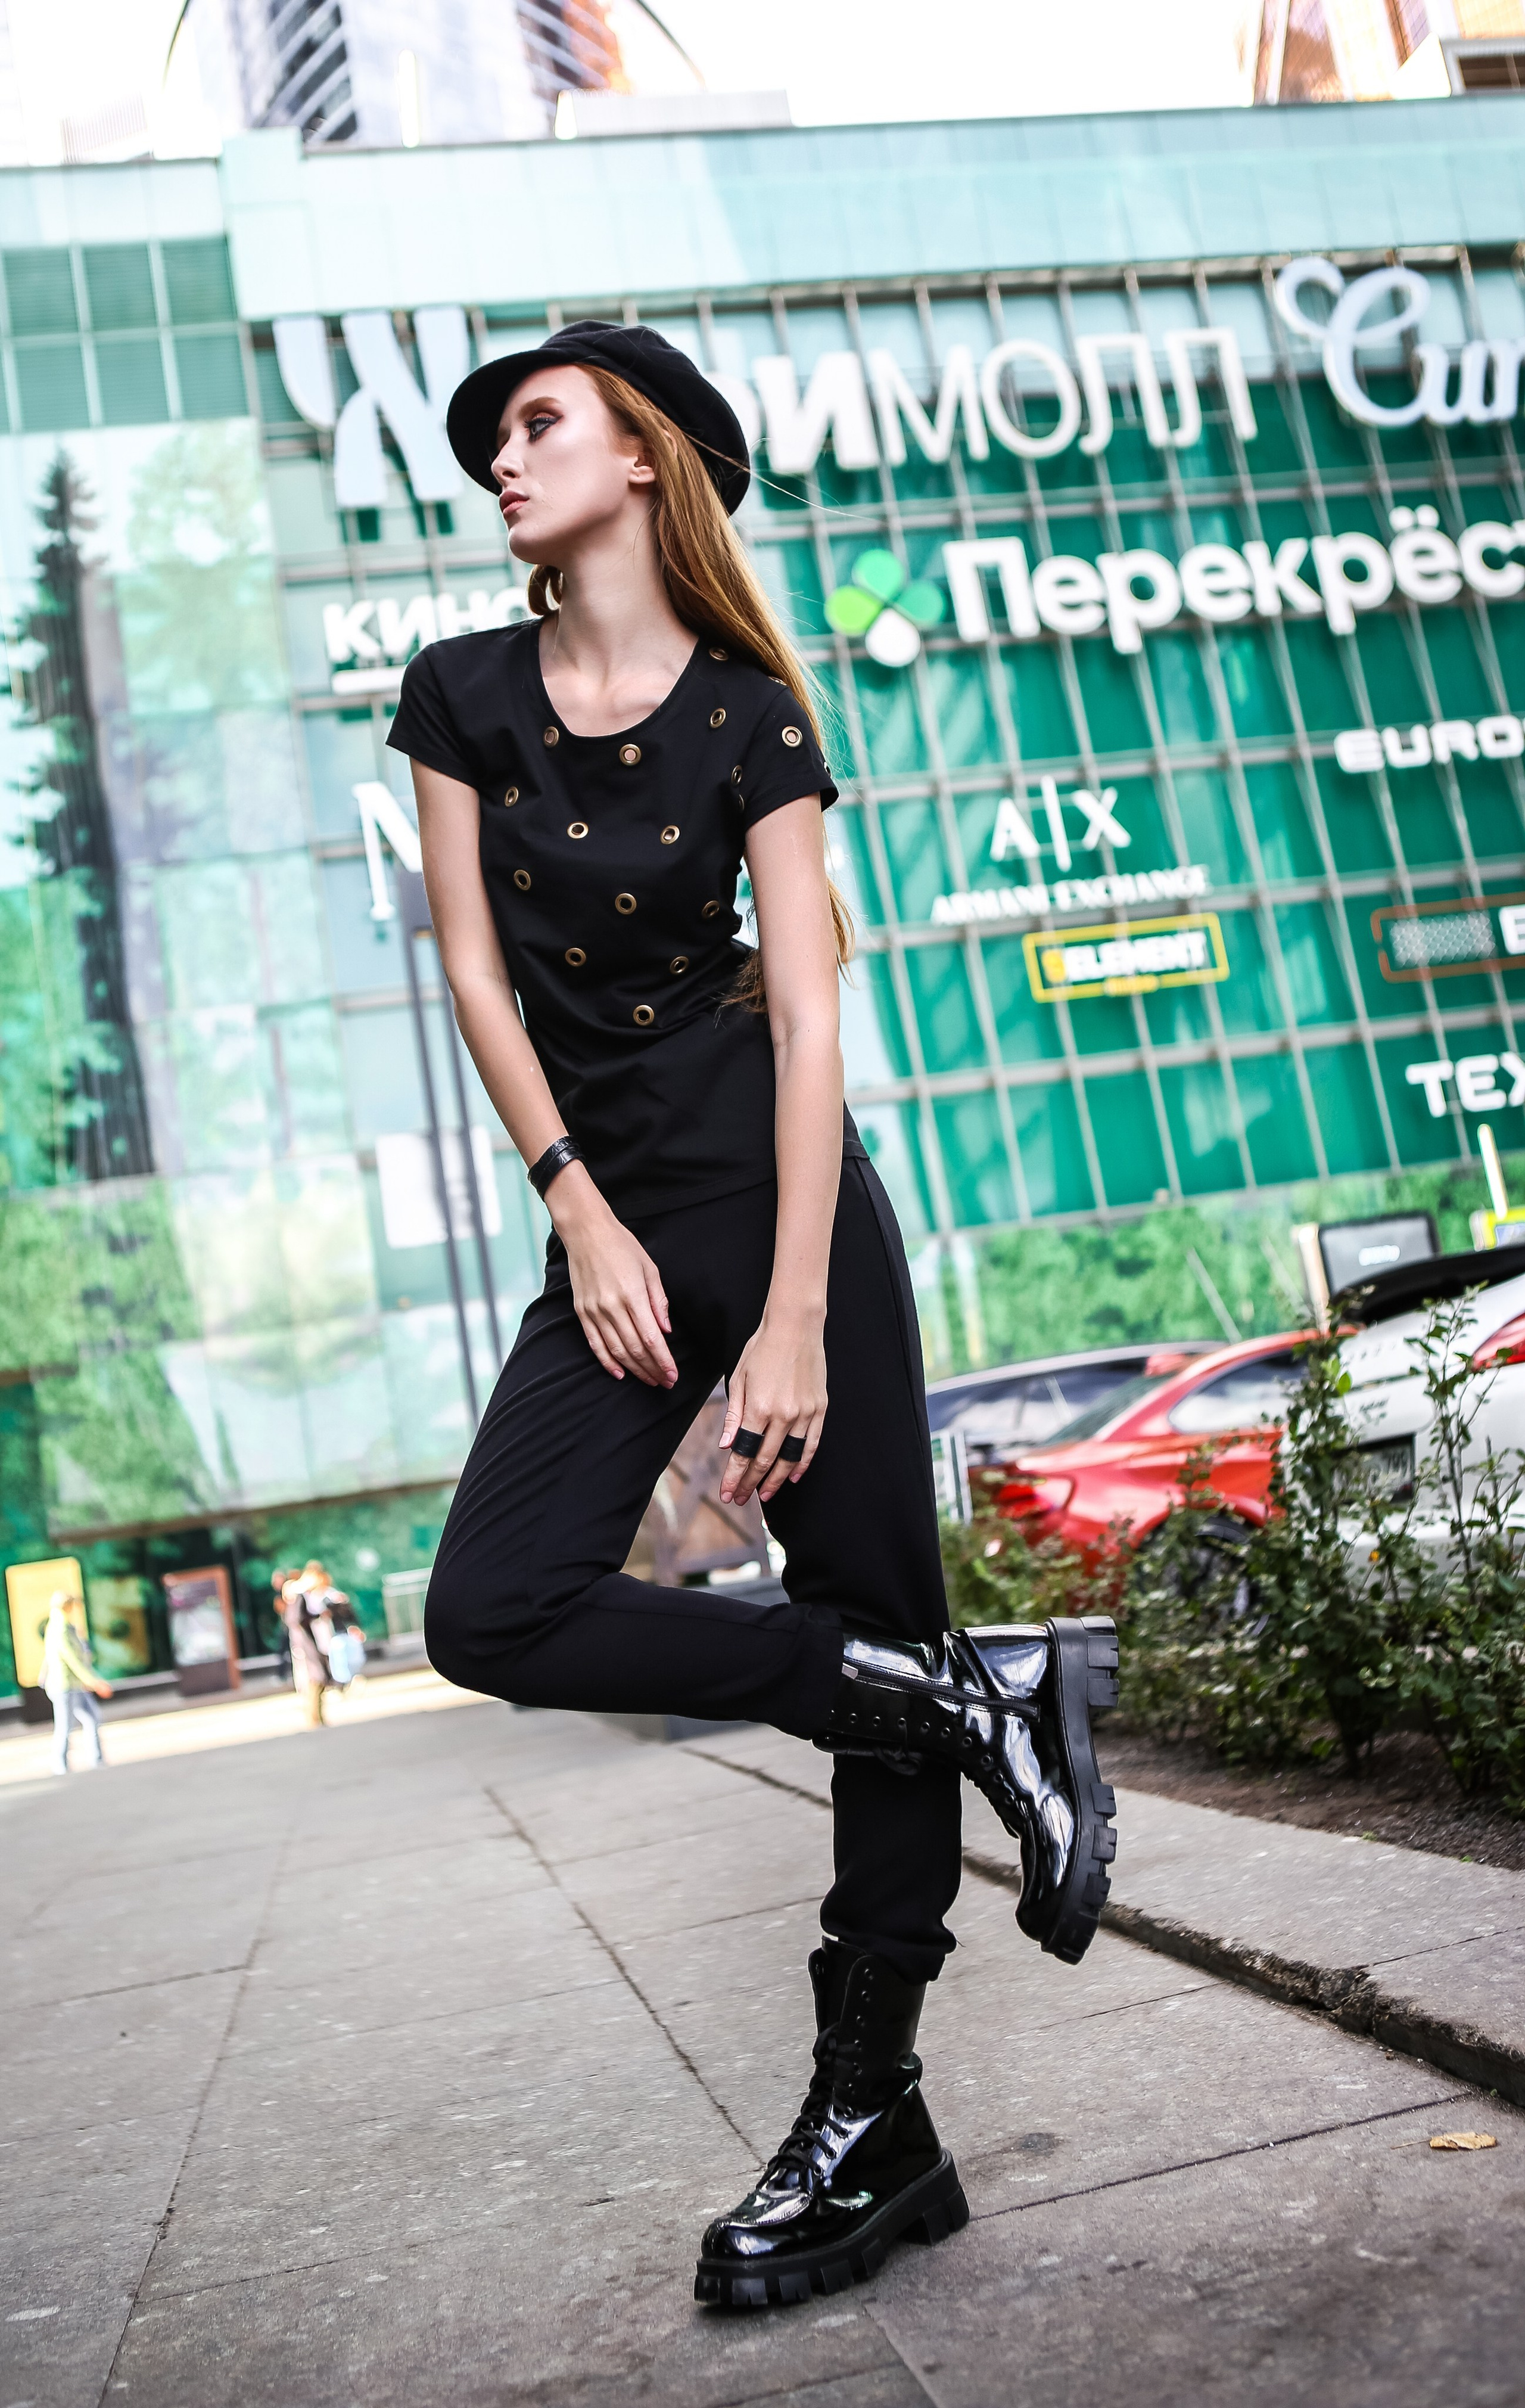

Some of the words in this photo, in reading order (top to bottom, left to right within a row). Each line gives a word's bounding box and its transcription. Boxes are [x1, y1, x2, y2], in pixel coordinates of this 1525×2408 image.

[943, 504, 1525, 656] Перекрёс
[930, 883, 1051, 925] ARMANI
[1053, 864, 1209, 912] EXCHANGE
